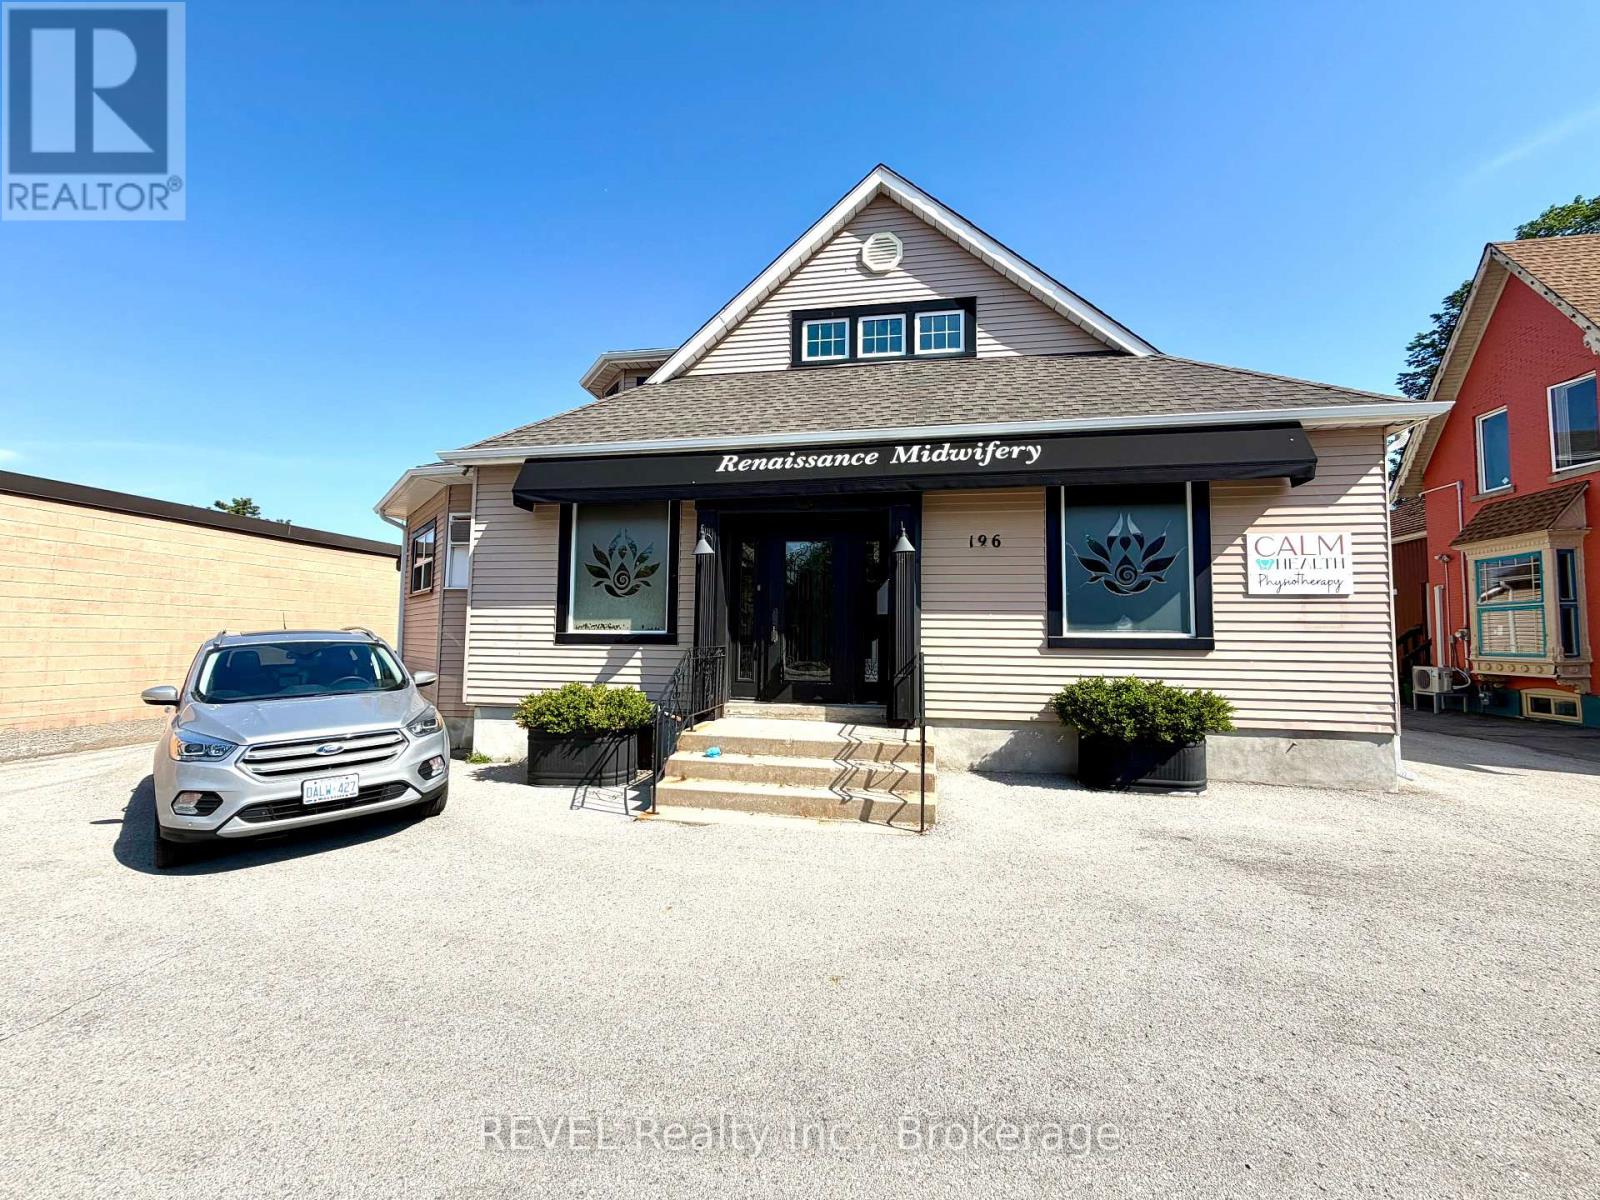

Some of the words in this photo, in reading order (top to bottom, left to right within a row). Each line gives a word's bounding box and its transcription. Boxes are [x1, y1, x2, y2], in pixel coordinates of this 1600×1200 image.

[715, 450, 880, 473] Renaissance
[889, 440, 1042, 467] Midwifery
[969, 534, 1002, 549] 196
[1254, 534, 1345, 558] CALM
[1276, 558, 1345, 570] HEALTH
[338, 780, 356, 793] 427
